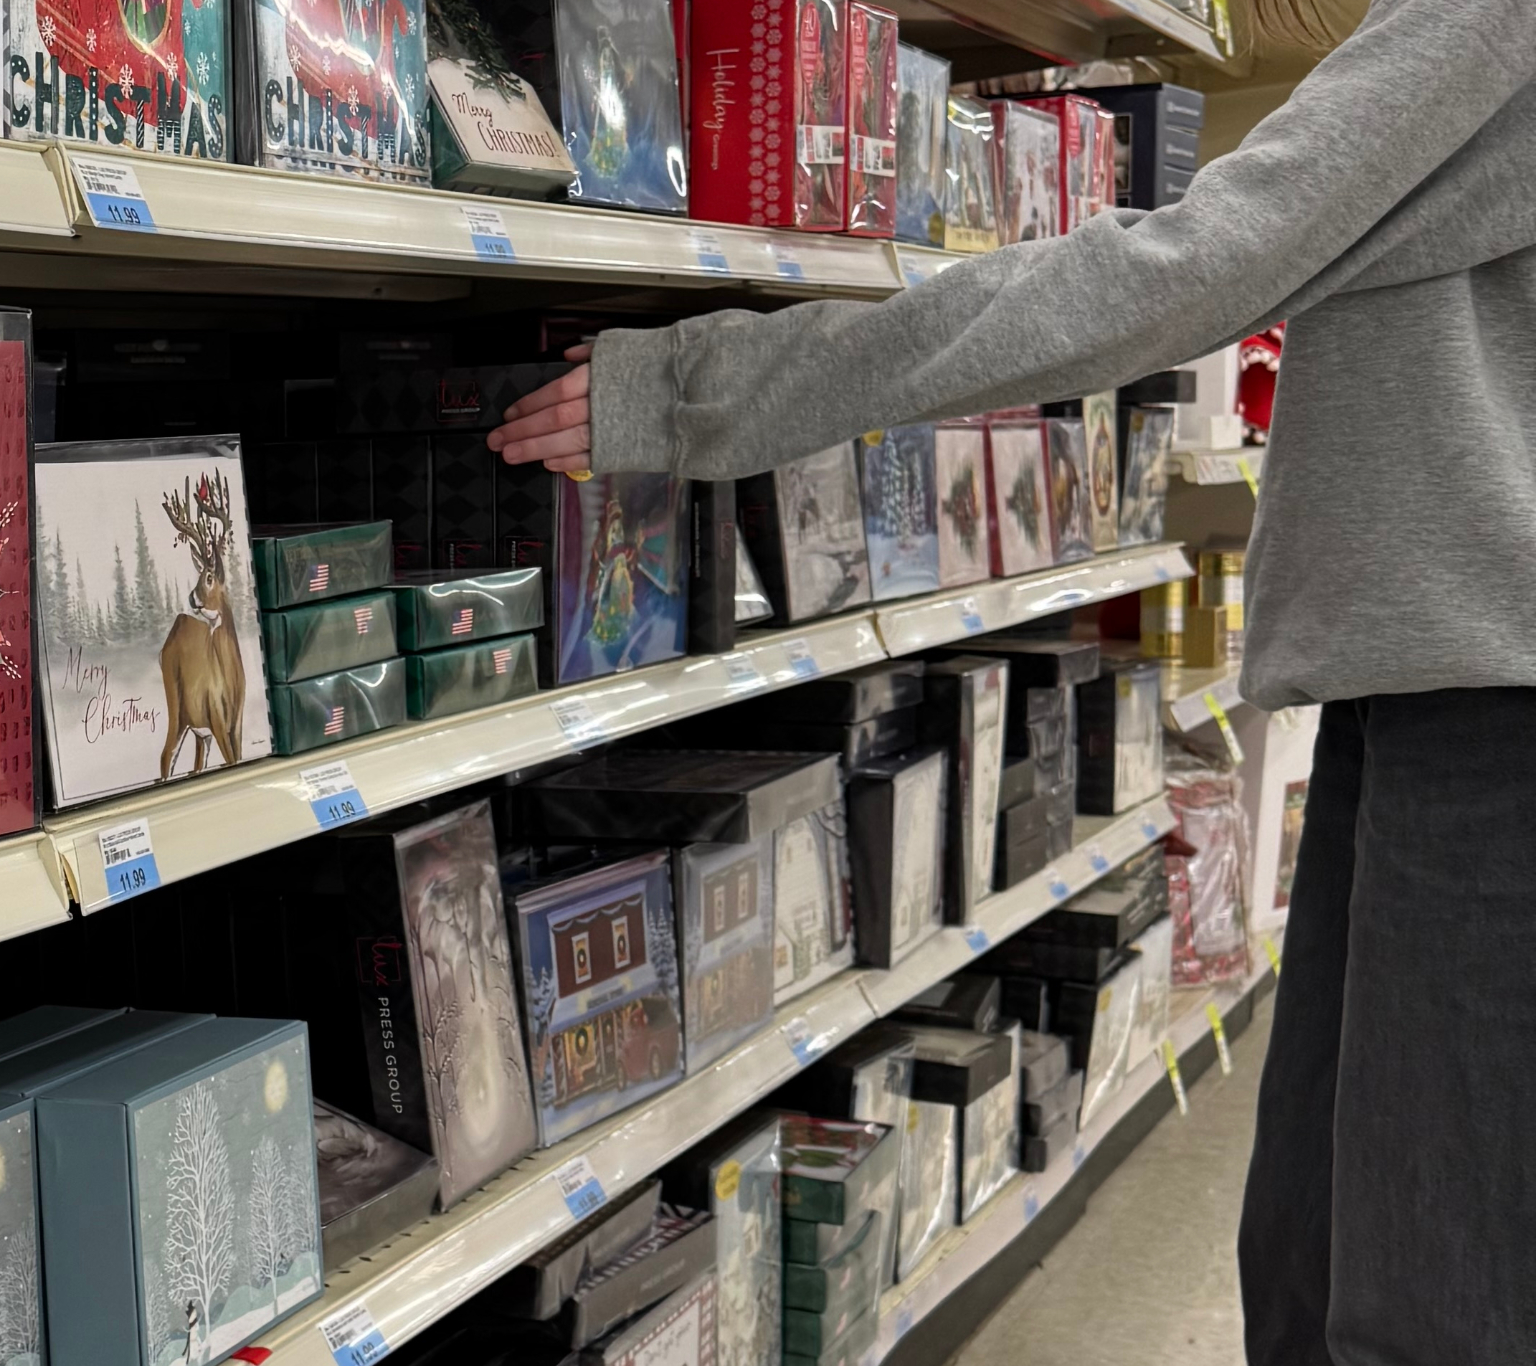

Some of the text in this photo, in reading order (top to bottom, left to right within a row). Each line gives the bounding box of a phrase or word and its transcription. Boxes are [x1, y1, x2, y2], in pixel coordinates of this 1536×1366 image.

[8, 50, 225, 161] CHRISTMAS
[451, 92, 494, 128] Merry
[702, 48, 740, 130] Holiday
[264, 74, 430, 169] CHRISTMAS
[476, 121, 562, 160] CHRISTMAS!
[107, 204, 141, 225] 11.99
[61, 645, 111, 702] Merry
[81, 693, 161, 744] Christmas
[328, 800, 357, 822] 11.99
[119, 867, 147, 893] 11.99
[377, 996, 404, 1114] PRESS GROUP
